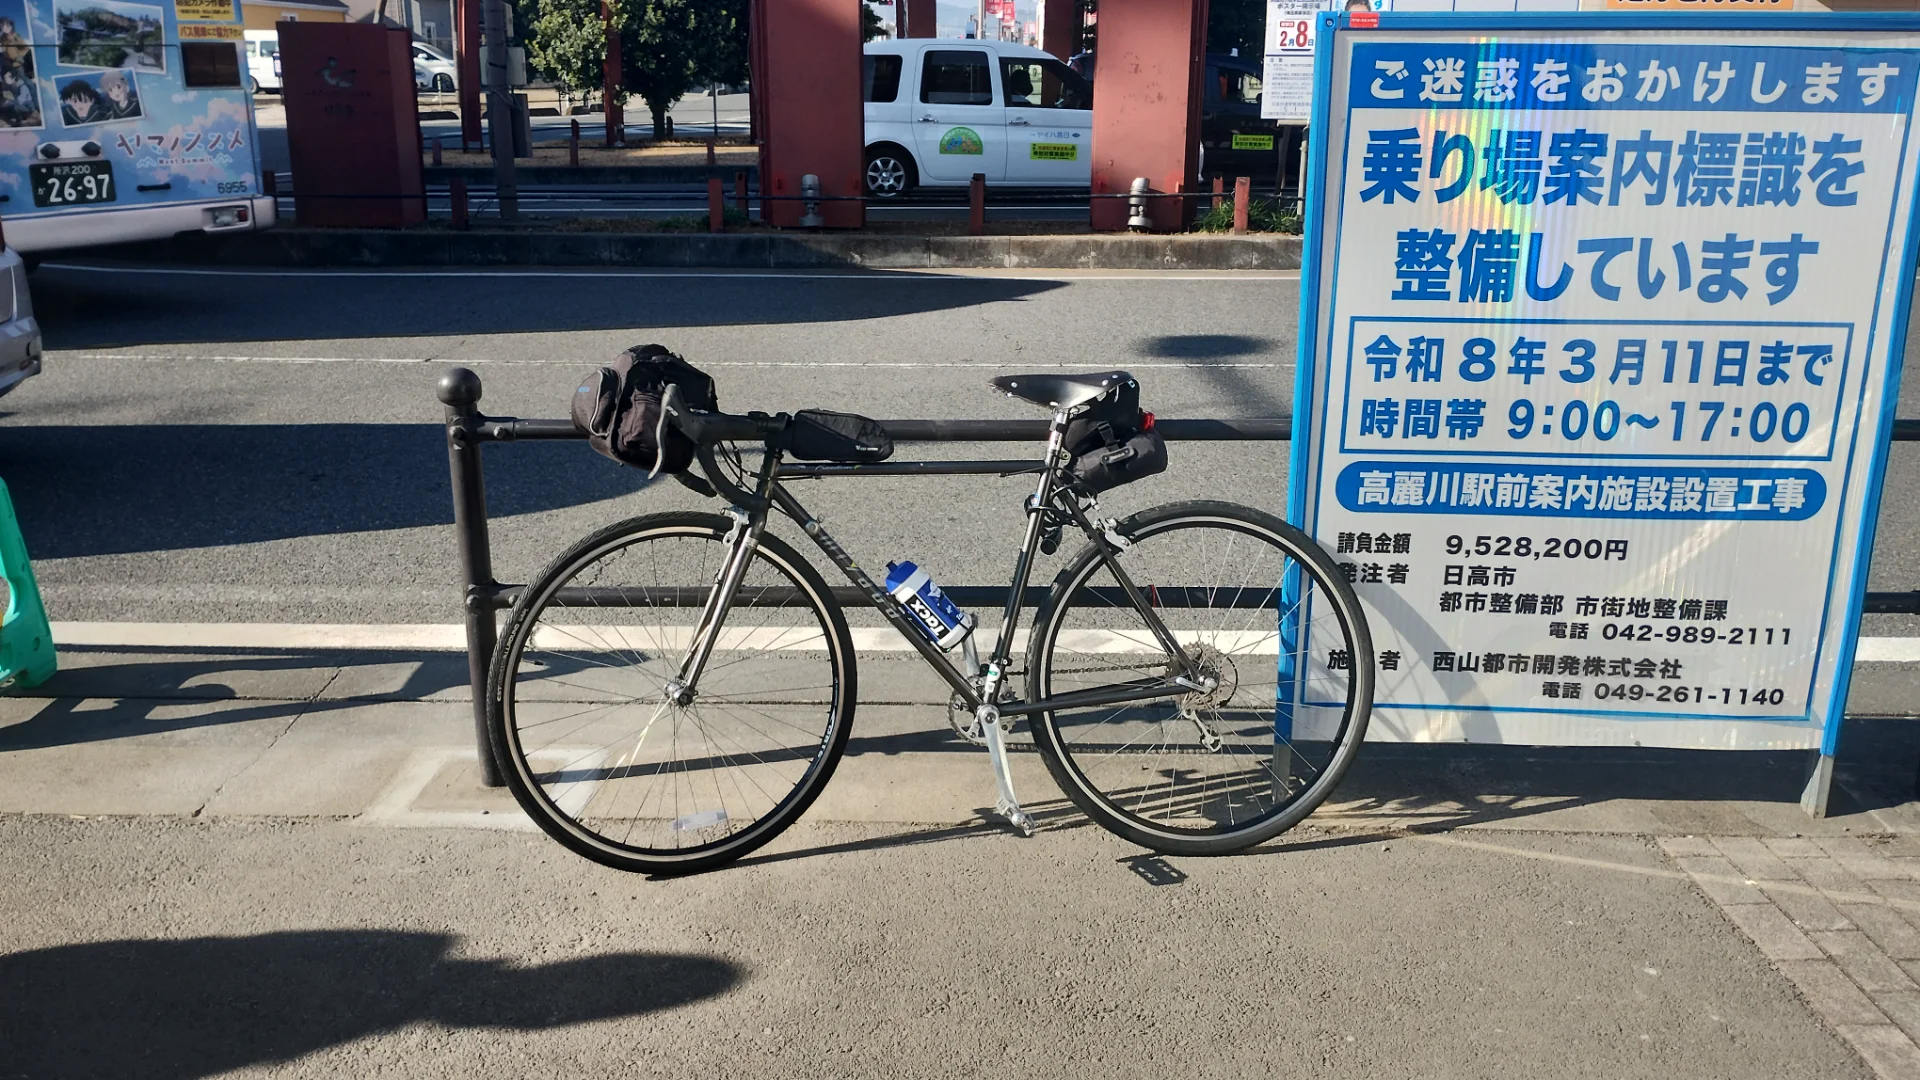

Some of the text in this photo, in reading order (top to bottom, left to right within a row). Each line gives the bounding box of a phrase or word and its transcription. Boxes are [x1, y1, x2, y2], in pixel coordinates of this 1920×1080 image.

[1280, 20, 1314, 47] 2月8日
[1370, 58, 1899, 105] ご迷惑をおかけします
[117, 129, 244, 156] ヤマノススメ
[1359, 128, 1867, 207] 乗り場案内標識を
[47, 173, 110, 203] 26-97
[217, 181, 248, 194] 6955
[1391, 228, 1819, 306] 整備しています
[1363, 334, 1835, 388] 令和8年3月11日まで
[1359, 397, 1487, 441] 時間帯
[1357, 469, 1807, 513] 高麗川駅前案内施設設置工事
[1337, 532, 1629, 561] 請負金額 9,528,200円
[1443, 565, 1517, 587] 日高市
[910, 599, 945, 637] Tacx
[1440, 591, 1728, 620] 都市整備部 市街地整備課
[1549, 621, 1791, 645] 電話 042-989-2111
[1327, 649, 1683, 680] 施者 西山都市開発株式会社
[1542, 681, 1785, 706] 電話 049-261-1140
